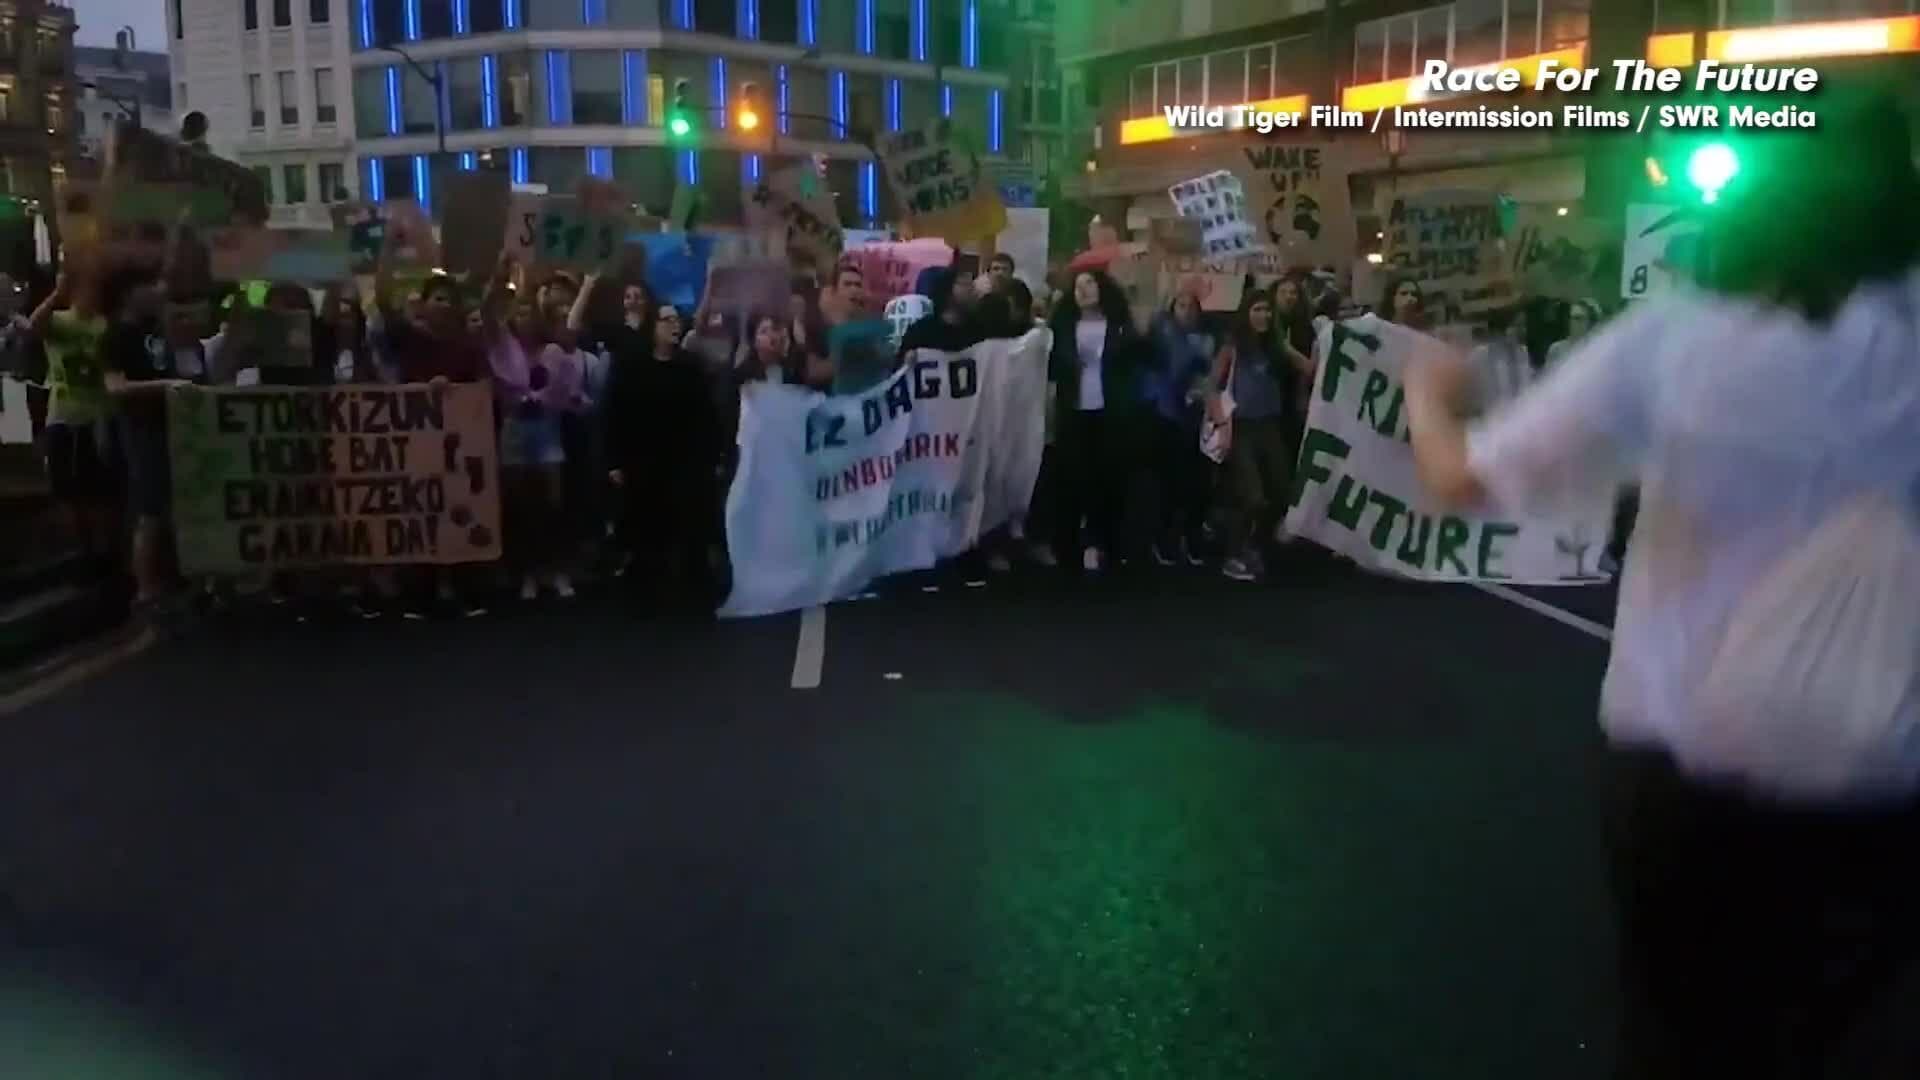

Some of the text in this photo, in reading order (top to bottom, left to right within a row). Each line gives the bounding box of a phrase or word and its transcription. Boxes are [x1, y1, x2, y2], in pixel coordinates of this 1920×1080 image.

[1243, 144, 1322, 169] WAKE
[862, 358, 976, 436] DAGO
[349, 435, 411, 473] BAT
[1294, 428, 1519, 580] FUTURE
